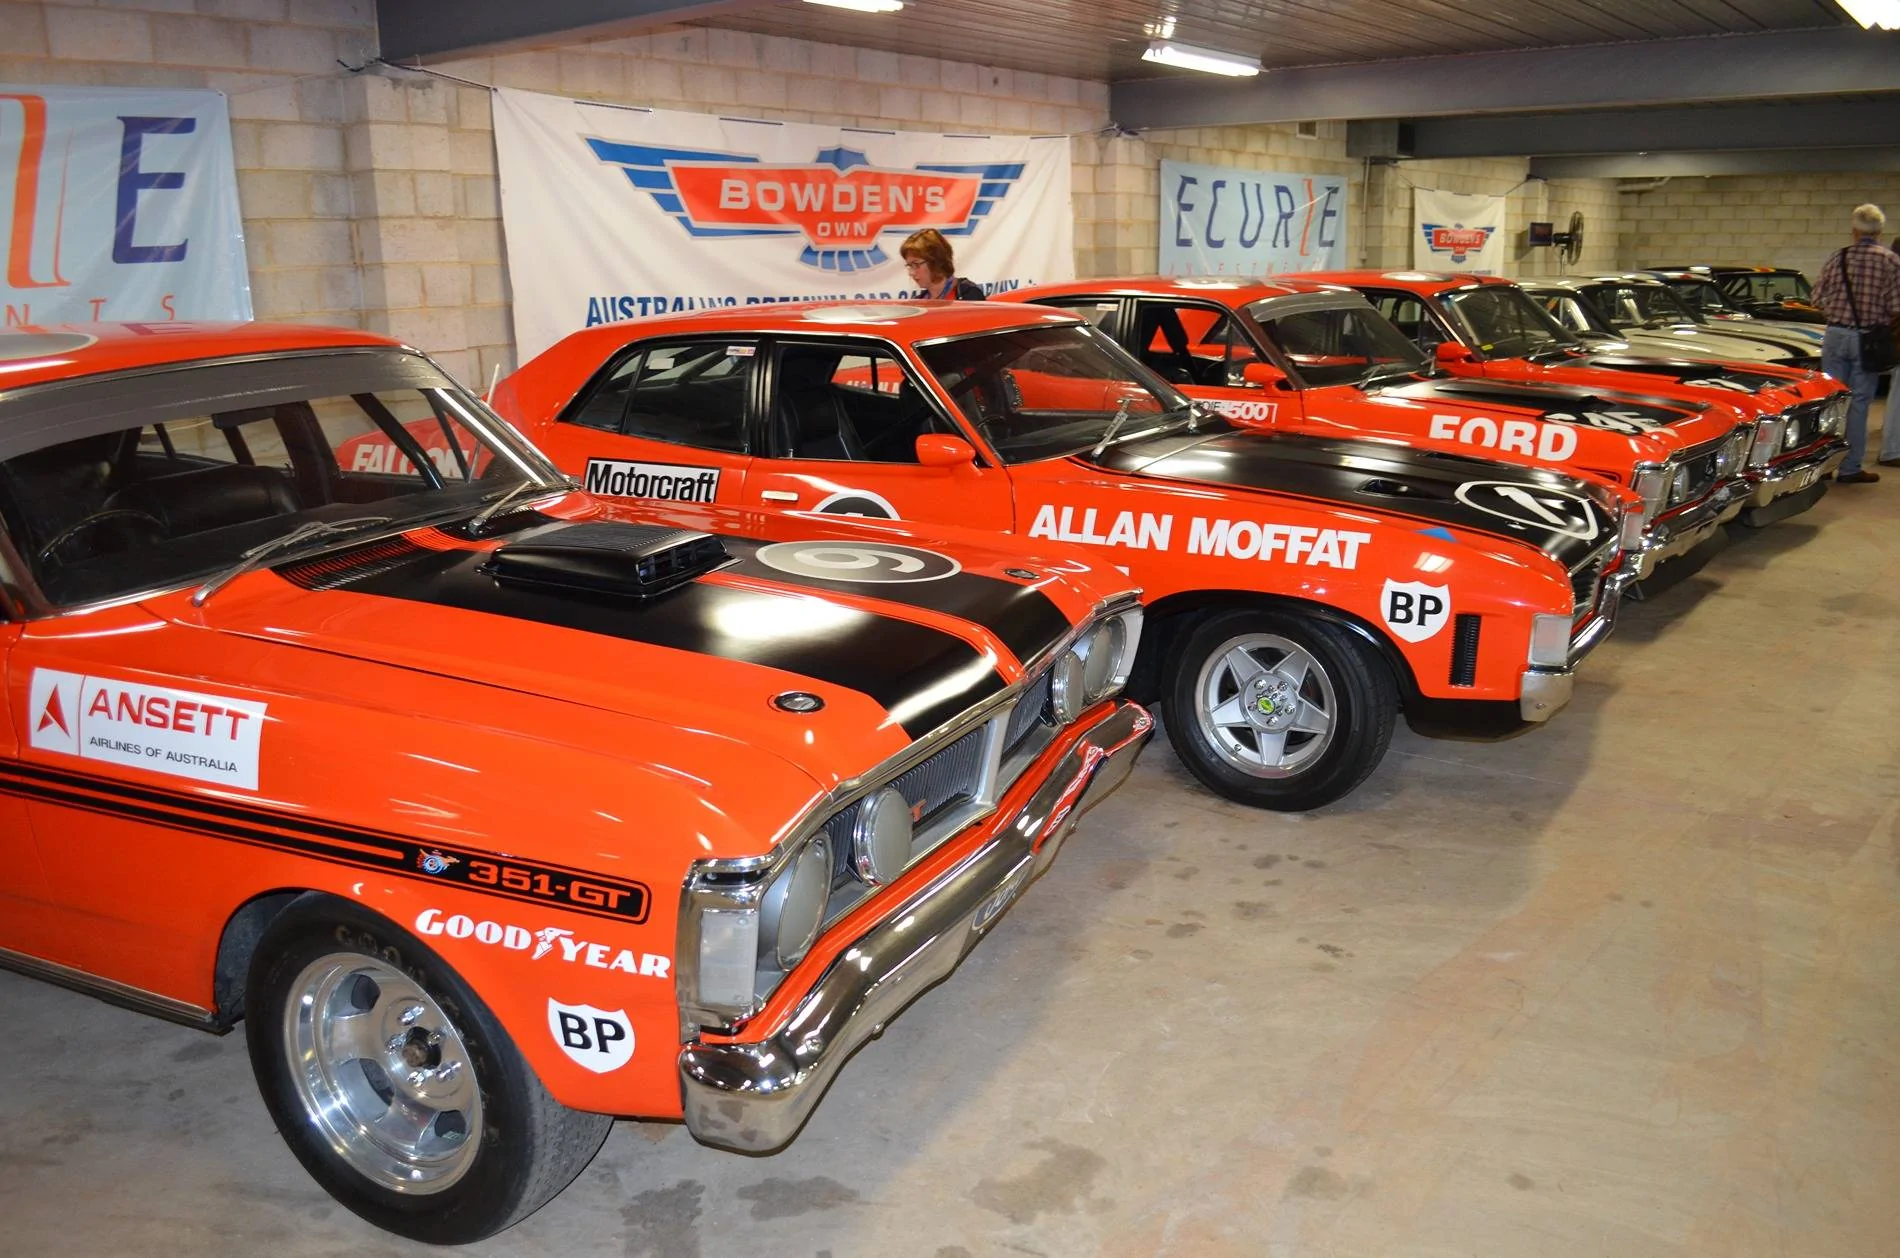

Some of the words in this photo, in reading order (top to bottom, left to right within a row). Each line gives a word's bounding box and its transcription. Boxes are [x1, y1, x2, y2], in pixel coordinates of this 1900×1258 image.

[718, 178, 947, 214] BOWDEN'S
[1175, 174, 1340, 256] ECURIE
[816, 221, 869, 238] OWN
[1228, 402, 1270, 421] 500
[1428, 414, 1579, 462] FORD
[588, 462, 716, 503] Motorcraft
[1028, 504, 1173, 551] ALLAN
[1187, 517, 1371, 571] MOFFAT
[1387, 591, 1444, 627] BP
[88, 688, 250, 741] ANSETT
[89, 736, 142, 756] AIRLINES
[146, 746, 162, 758] OF
[166, 750, 238, 774] AUSTRALIA
[468, 860, 631, 910] 351-GT
[558, 1011, 626, 1055] BP
